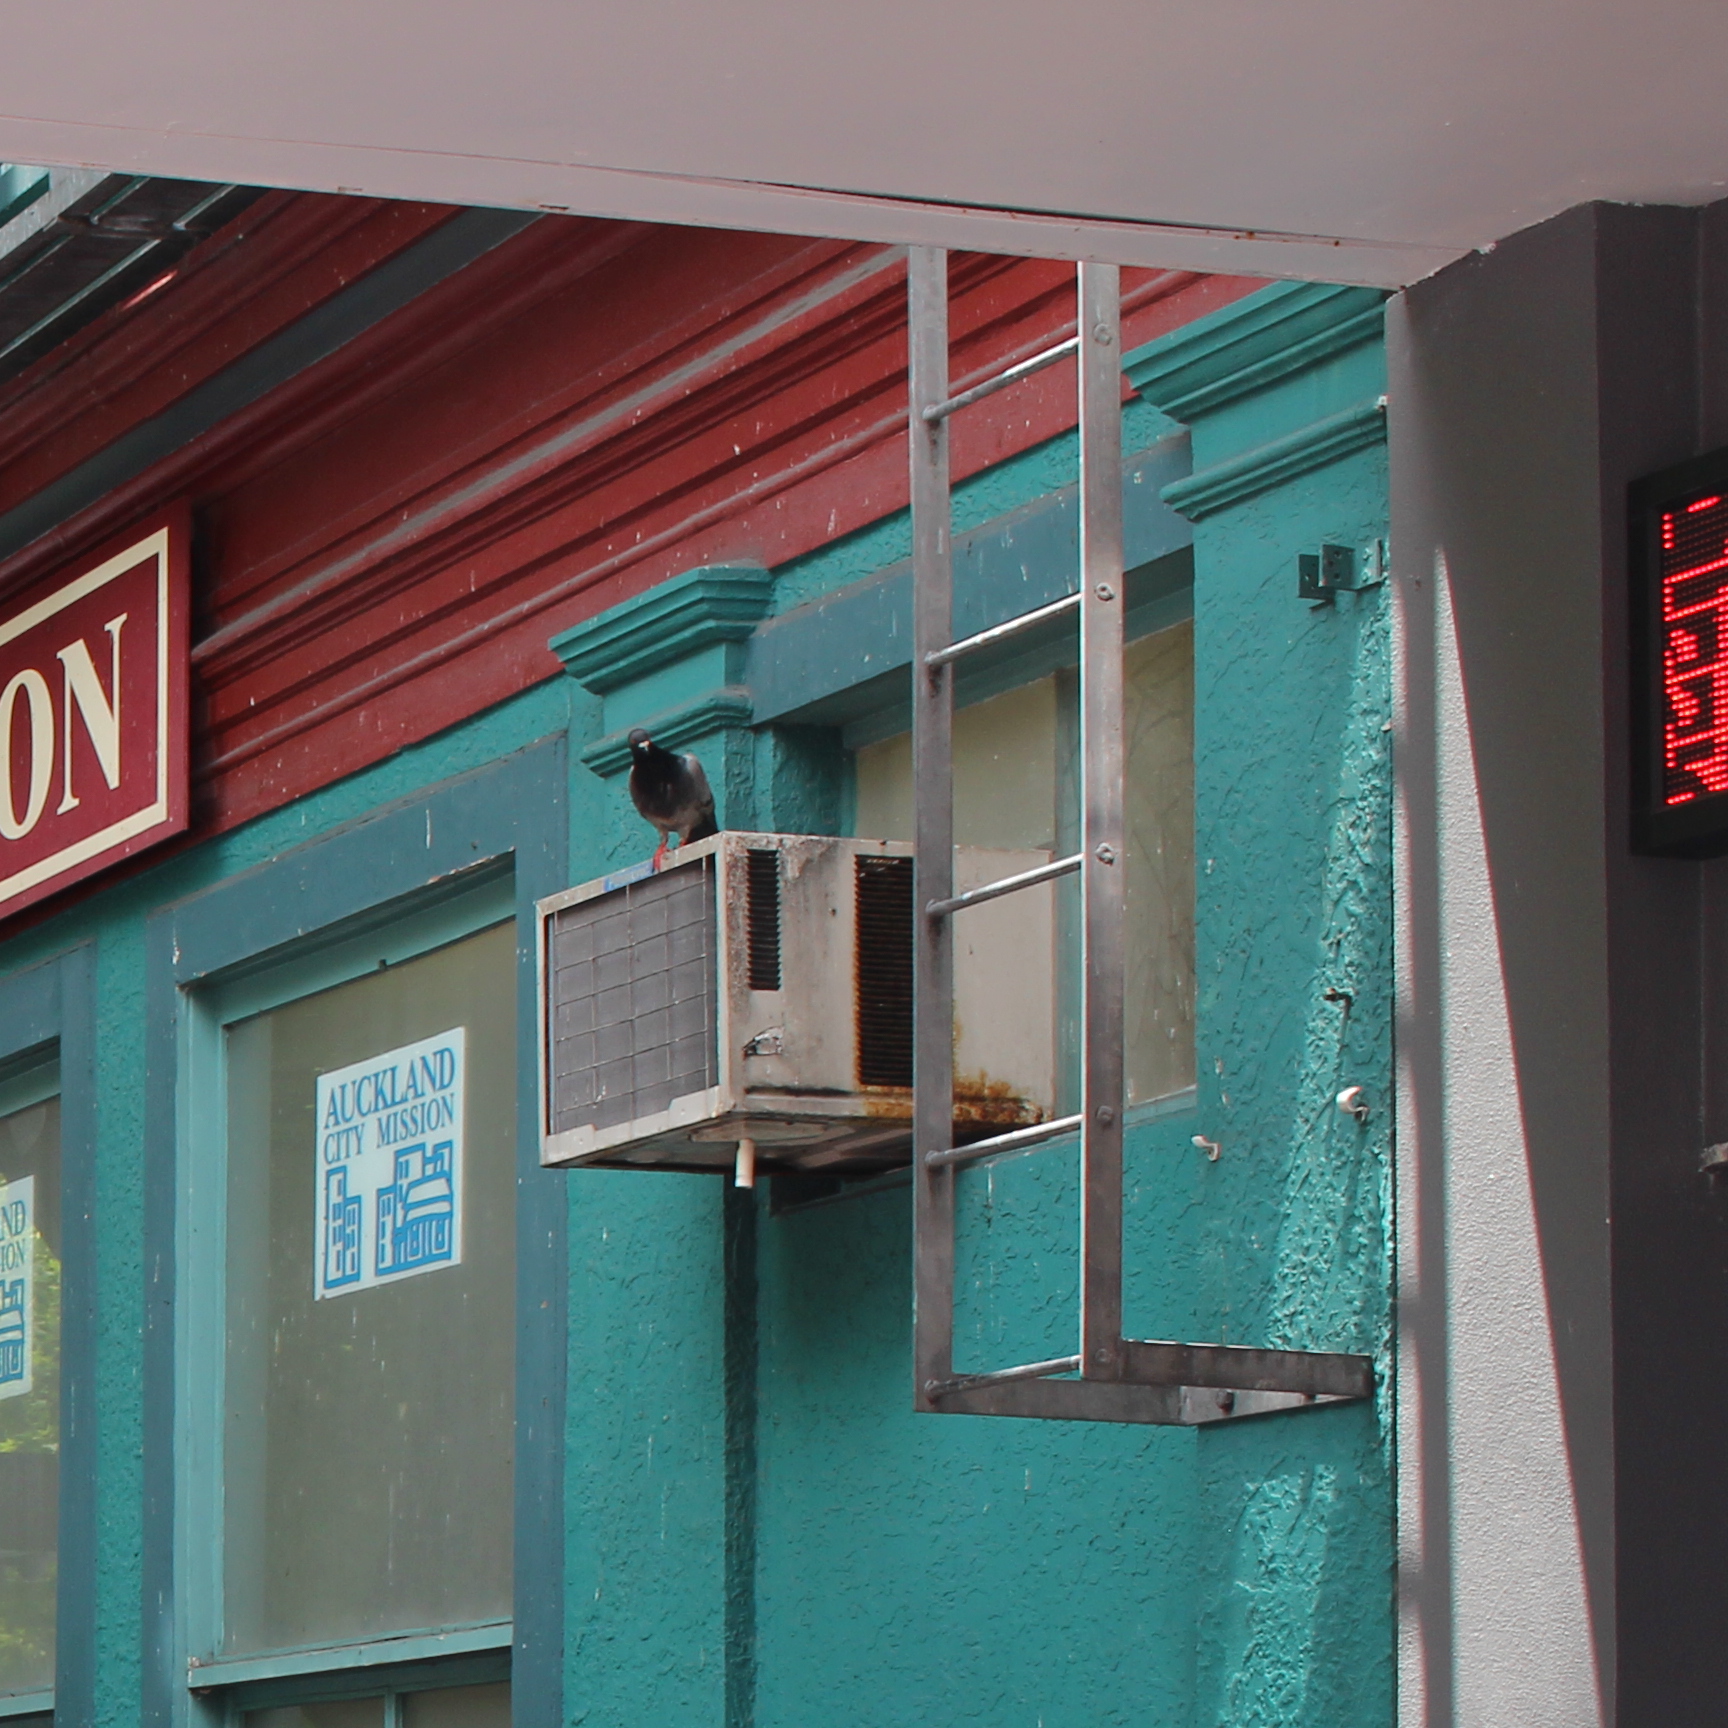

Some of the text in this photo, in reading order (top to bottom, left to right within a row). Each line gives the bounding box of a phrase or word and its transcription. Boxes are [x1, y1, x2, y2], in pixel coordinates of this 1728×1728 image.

[323, 1046, 456, 1130] AUCKLAND
[323, 1092, 455, 1166] CITY MISSION
